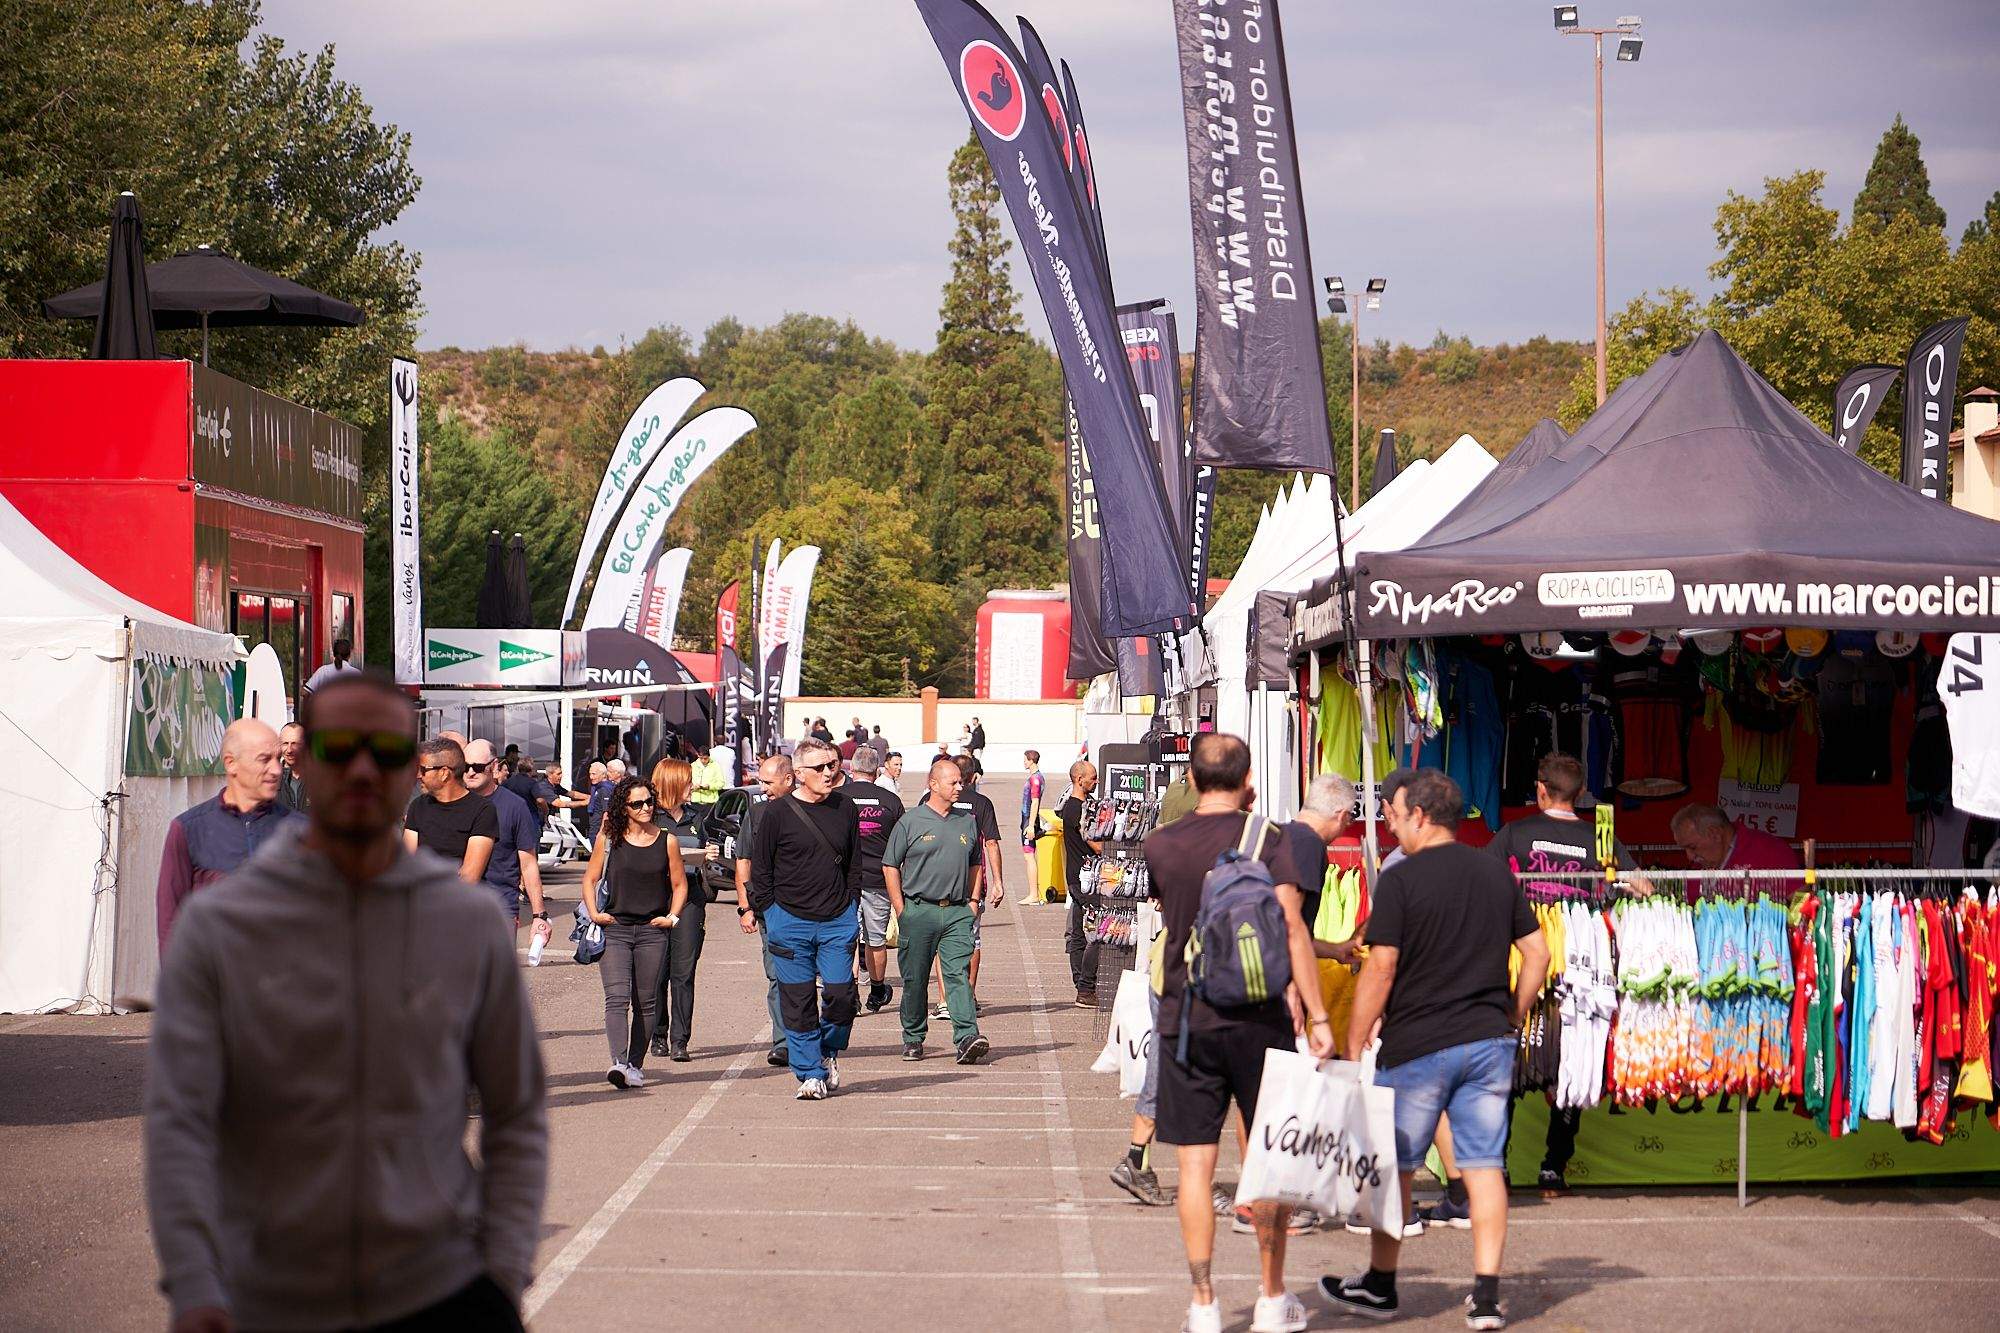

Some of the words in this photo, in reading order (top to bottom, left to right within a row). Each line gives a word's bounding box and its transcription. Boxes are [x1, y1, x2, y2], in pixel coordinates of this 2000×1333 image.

[399, 430, 413, 537] iberCaja
[611, 551, 635, 576] El
[623, 502, 661, 552] Corte
[643, 437, 707, 508] Inglés
[646, 586, 667, 638] AMAHA
[1547, 579, 1591, 599] ROPA
[1595, 575, 1666, 598] CICLISTA
